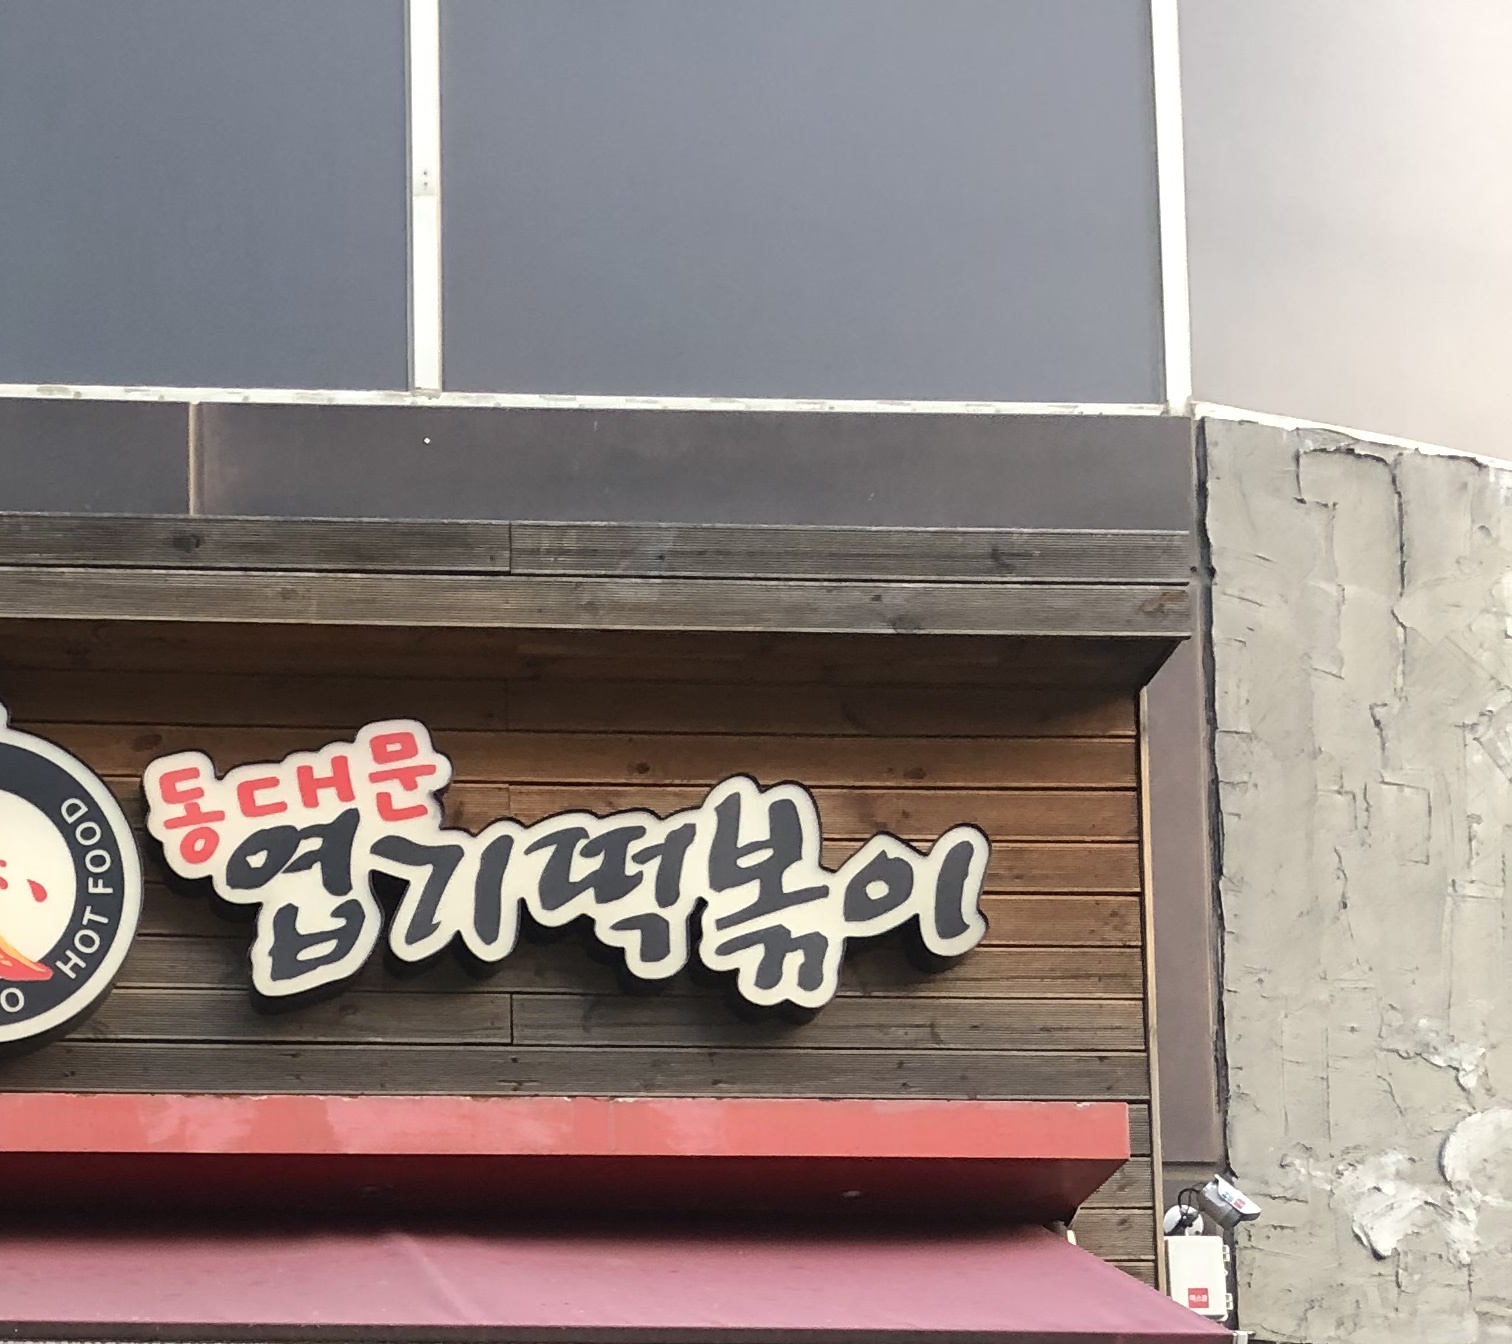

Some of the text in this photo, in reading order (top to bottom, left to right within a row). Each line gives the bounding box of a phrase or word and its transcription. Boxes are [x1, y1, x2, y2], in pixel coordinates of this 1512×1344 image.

[60, 796, 110, 895] FOOD
[157, 732, 438, 866] 동대문
[54, 905, 111, 981] HOT
[225, 790, 976, 993] 엽기떡볶이
